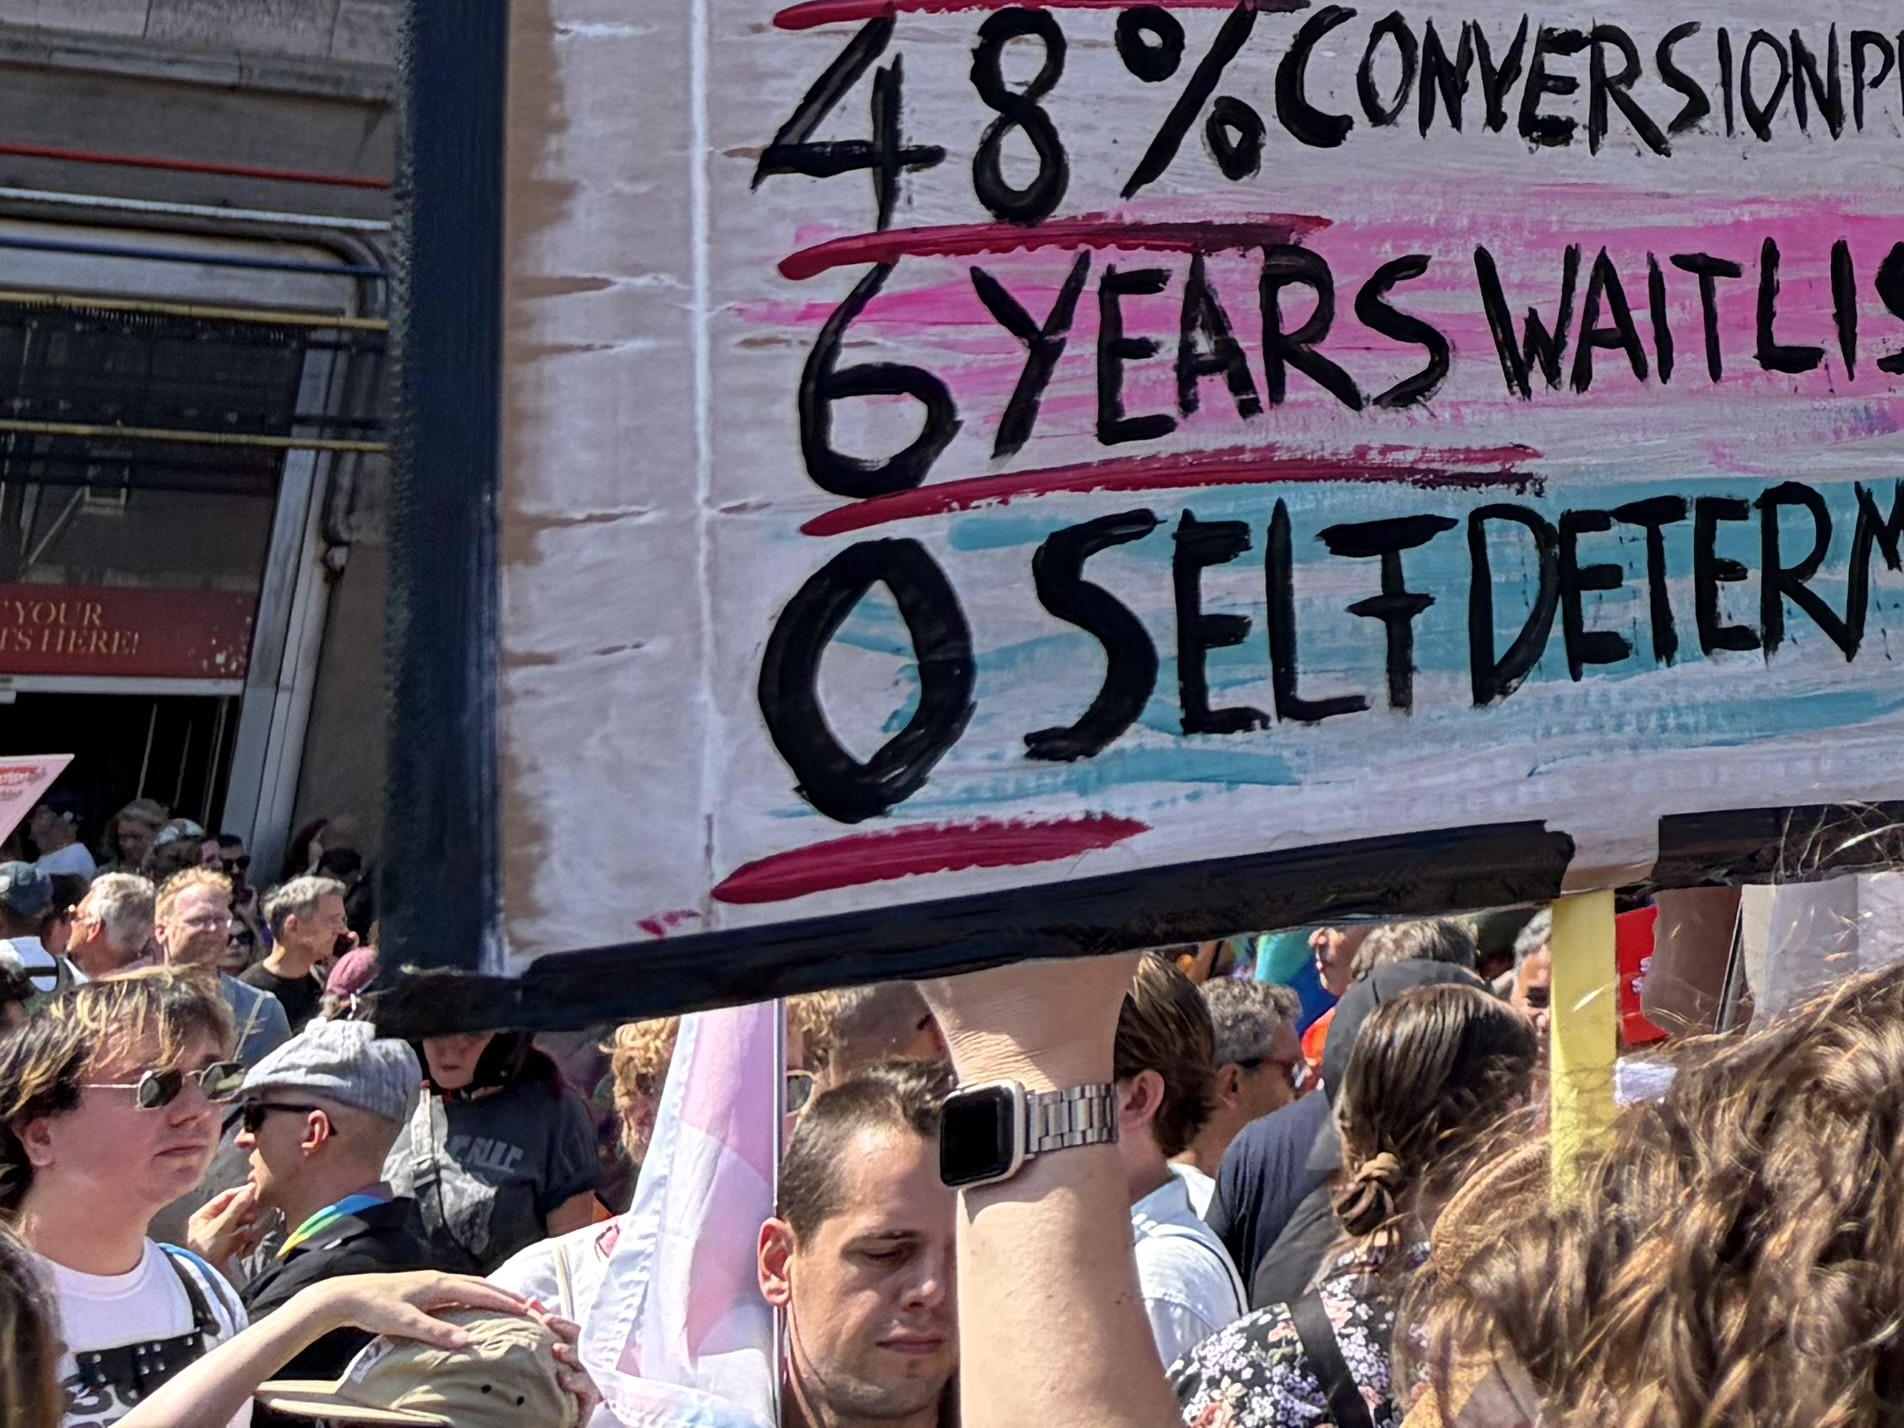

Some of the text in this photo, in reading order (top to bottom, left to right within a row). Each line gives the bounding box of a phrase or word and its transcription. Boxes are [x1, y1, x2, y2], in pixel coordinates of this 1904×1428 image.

[799, 258, 963, 498] 6
[969, 238, 1451, 460] YEARS
[15, 600, 102, 627] YOUR
[755, 537, 978, 824] 0
